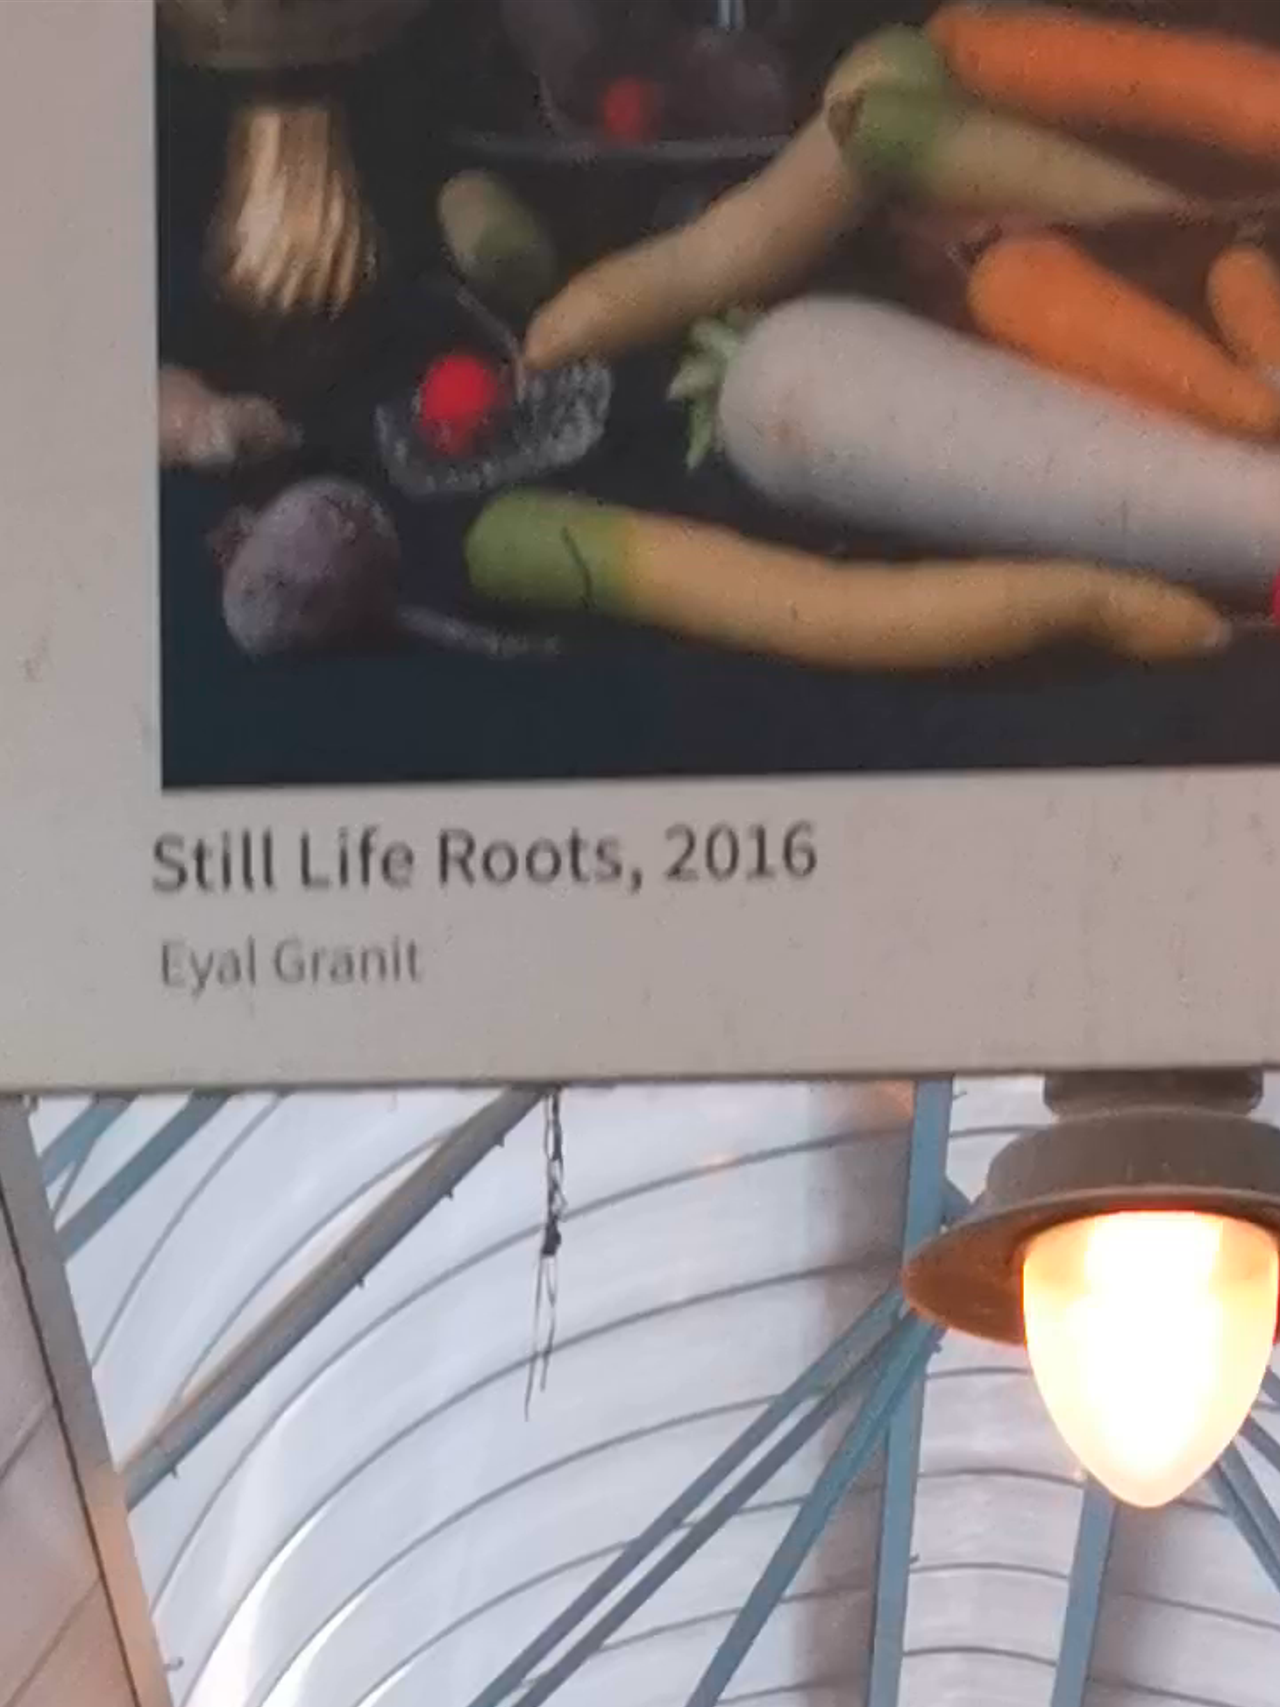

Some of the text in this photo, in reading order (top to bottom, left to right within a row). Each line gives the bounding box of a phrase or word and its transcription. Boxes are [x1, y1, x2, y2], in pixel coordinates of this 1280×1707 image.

[152, 820, 819, 893] Still Life Roots, 2016
[160, 935, 423, 997] Eyal Granit
